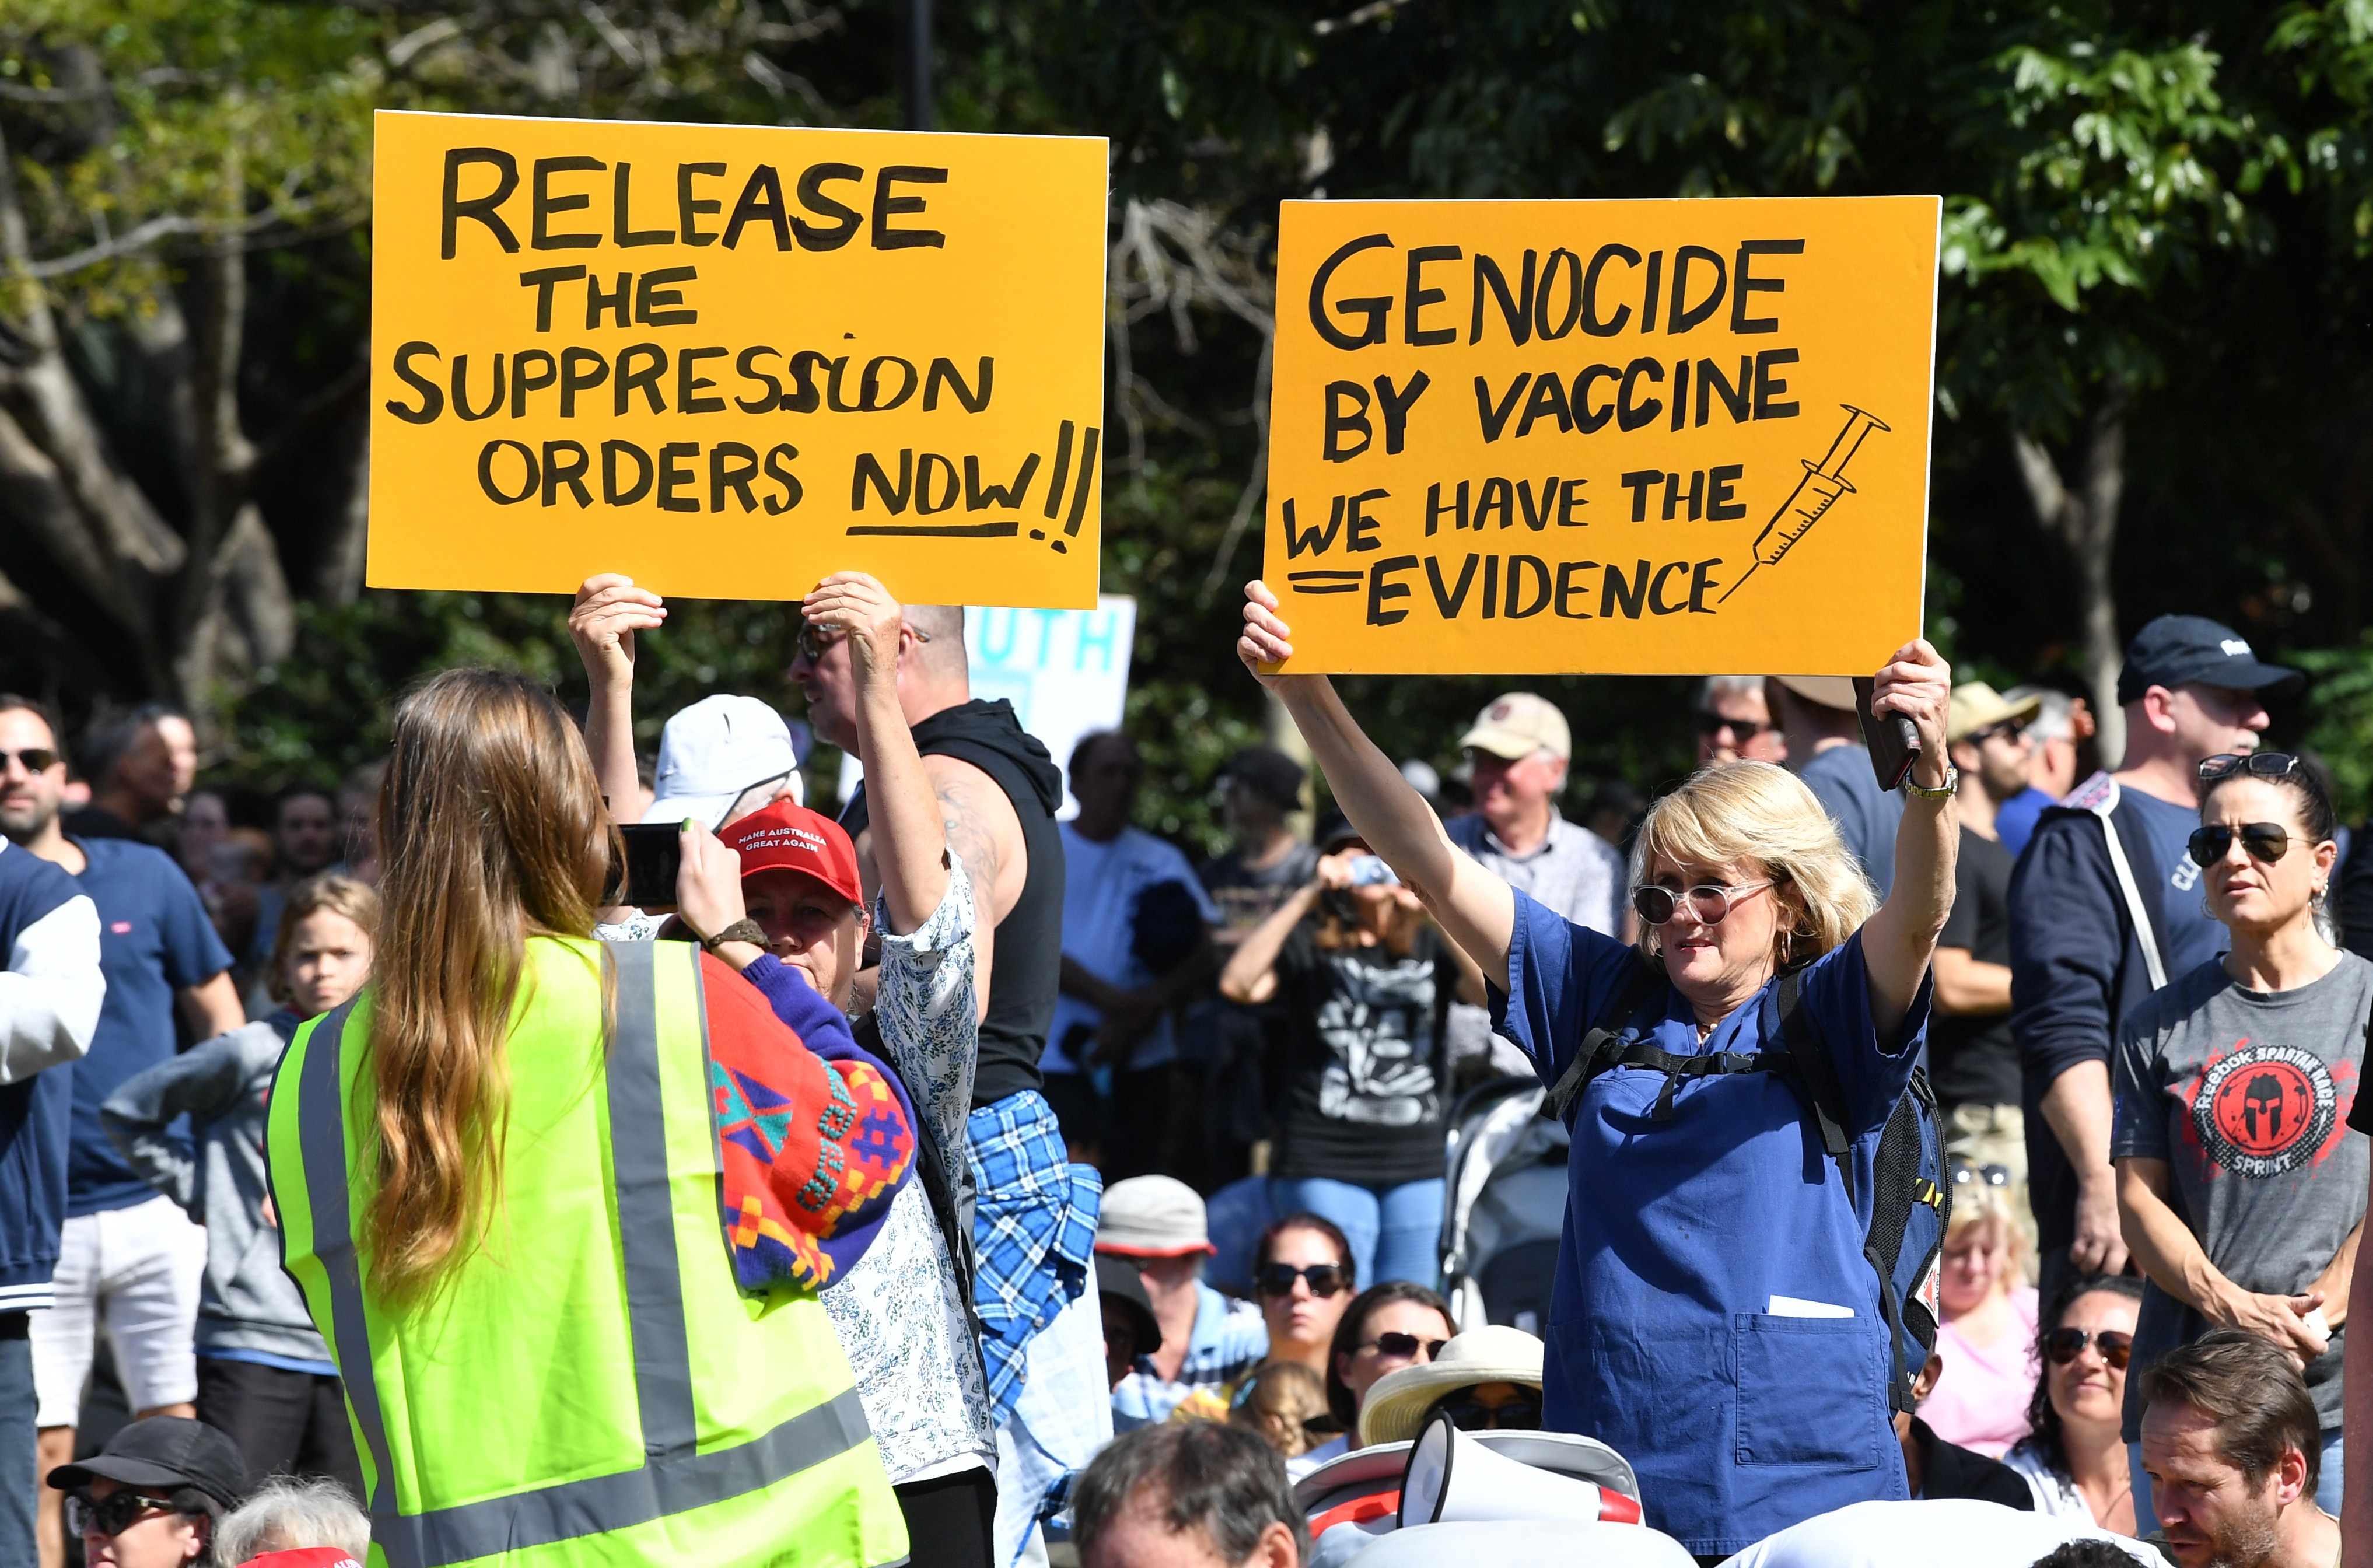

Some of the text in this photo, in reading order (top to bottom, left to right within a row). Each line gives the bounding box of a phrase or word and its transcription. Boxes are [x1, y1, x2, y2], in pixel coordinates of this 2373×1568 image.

[442, 148, 948, 260] RELEASE
[520, 265, 697, 332] THE
[1309, 234, 1805, 351] GENOCIDE
[1323, 348, 1799, 463] BY VACCINE
[478, 440, 803, 516] ORDERS
[1283, 464, 1746, 559] WE HAVE THE
[1367, 555, 1723, 626] EVIDENCE
[964, 607, 1118, 673] UTH
[738, 828, 827, 846] MAKE AUSTRALIA
[746, 839, 818, 852] GREAT AGAIN
[2196, 1047, 2335, 1110] Reebok SPARTAN RACE
[2232, 1153, 2292, 1175] SPRINT
